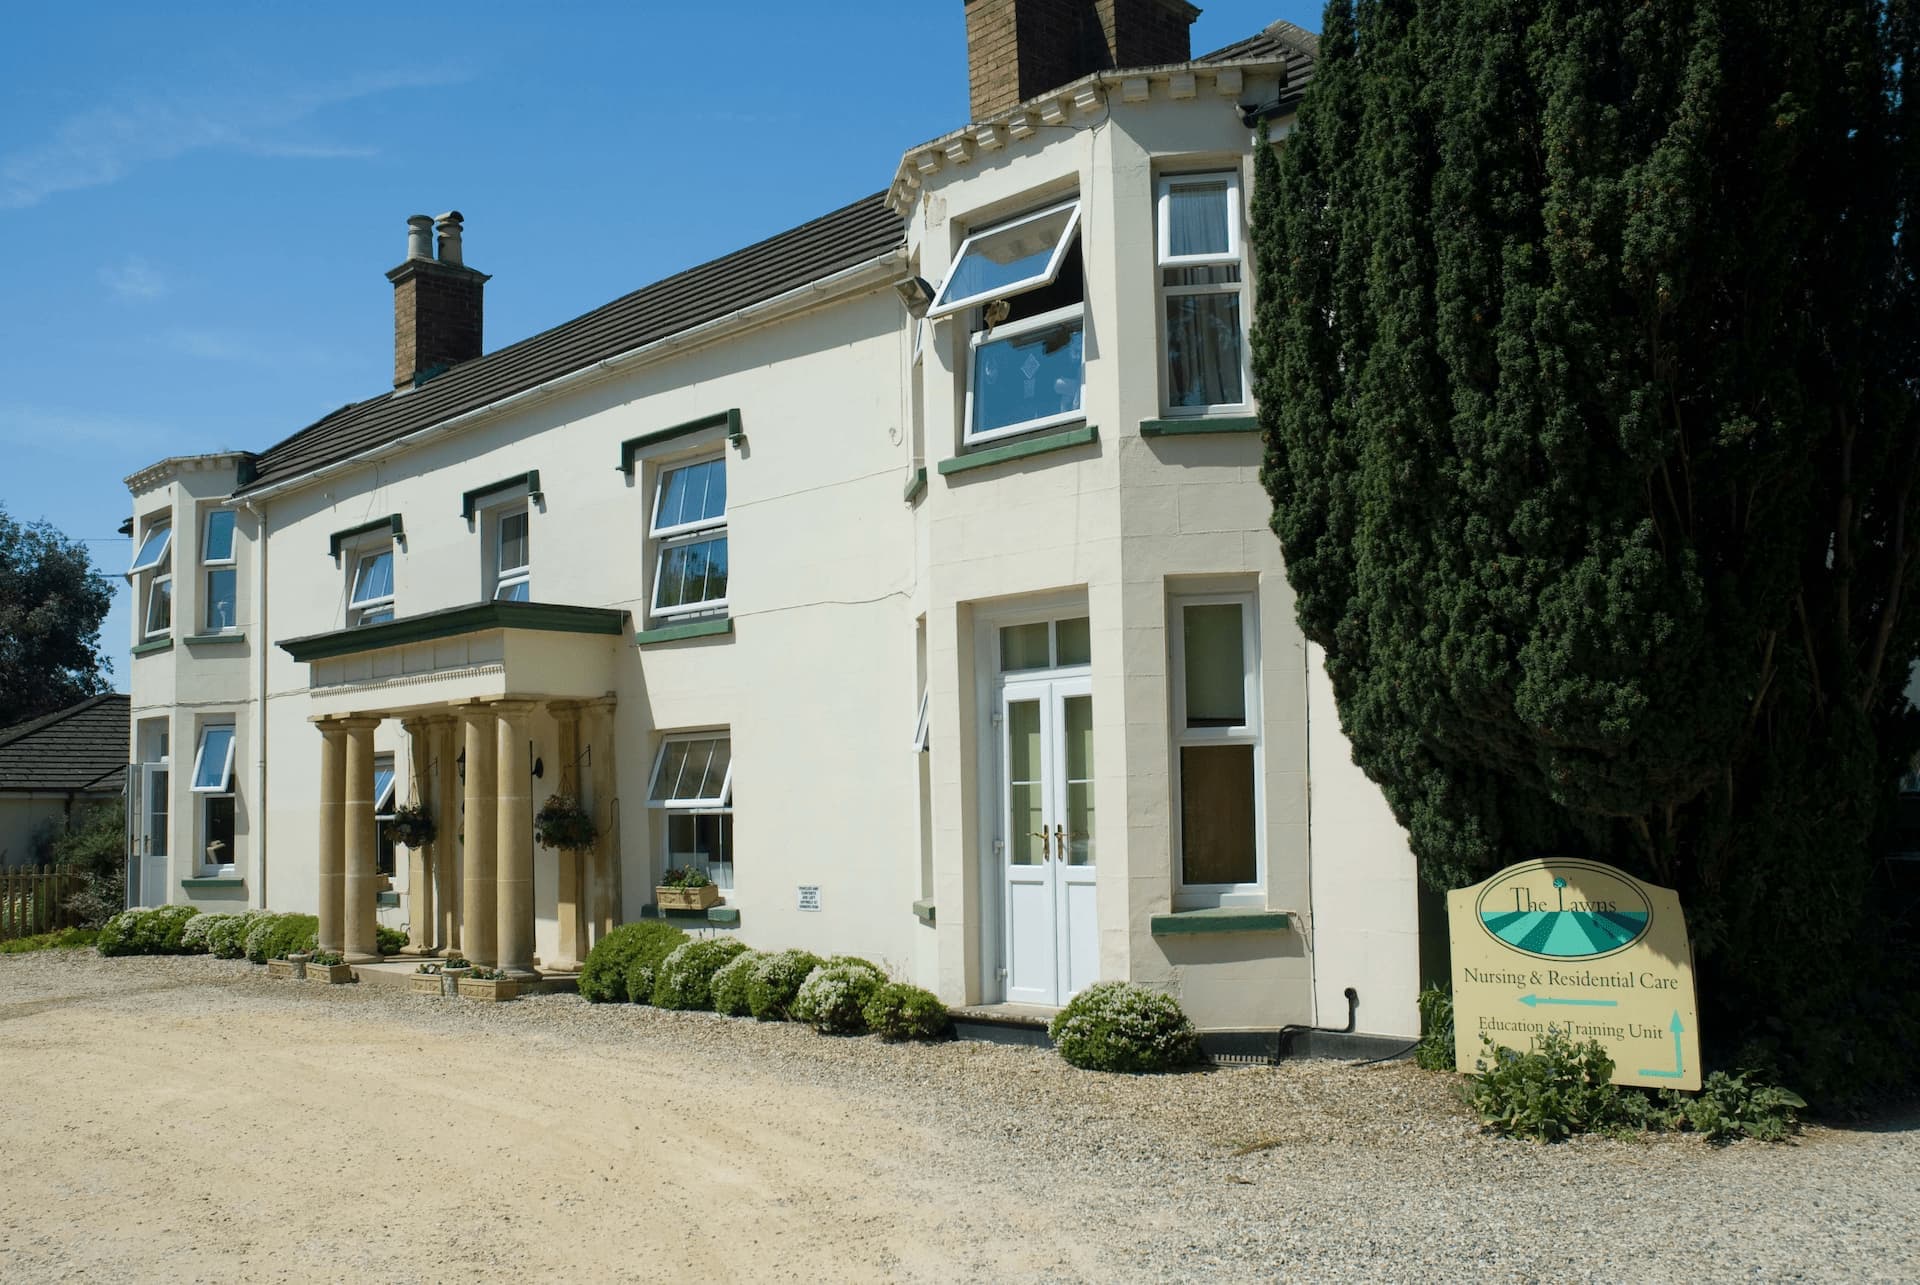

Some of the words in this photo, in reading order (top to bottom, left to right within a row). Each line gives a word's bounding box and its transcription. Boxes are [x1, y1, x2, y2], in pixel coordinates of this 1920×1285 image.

[1509, 887, 1548, 912] The
[1556, 886, 1618, 912] Lawns
[1463, 967, 1526, 989] Nursing
[1530, 970, 1543, 985] &
[1548, 970, 1635, 988] Residential
[1639, 972, 1679, 990] Care
[1479, 1016, 1544, 1033] Education
[1548, 1020, 1562, 1035] &
[1563, 1020, 1625, 1041] Training
[1628, 1023, 1664, 1040] Unit
